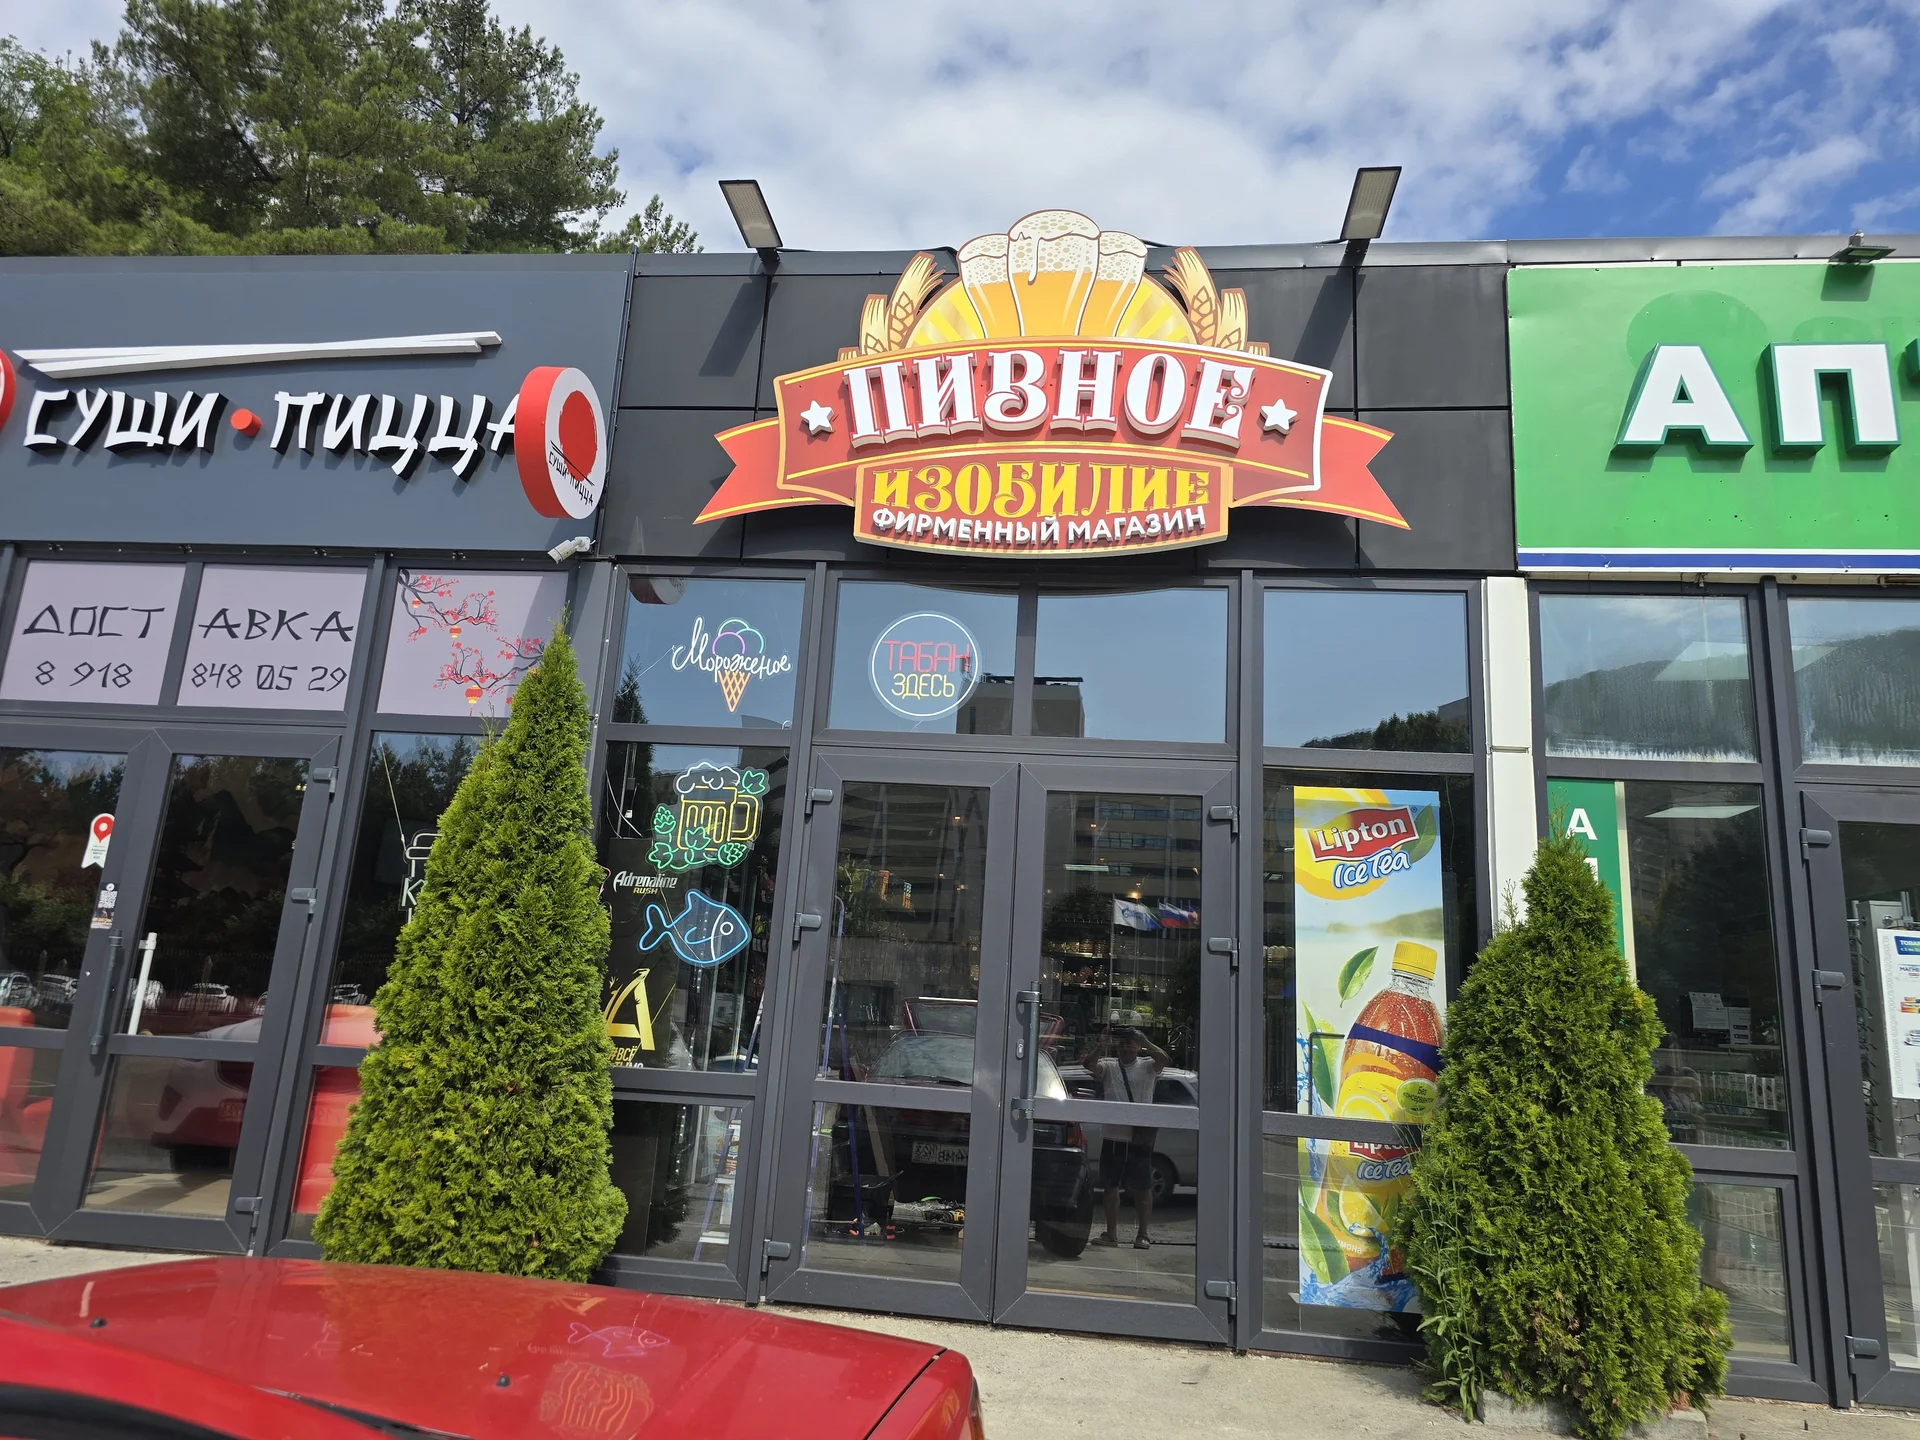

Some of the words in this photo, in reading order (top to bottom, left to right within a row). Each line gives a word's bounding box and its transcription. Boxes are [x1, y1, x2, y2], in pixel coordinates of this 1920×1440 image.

[843, 347, 1256, 449] ПИВНОЕ
[1614, 340, 1920, 449] АП
[23, 387, 226, 452] СУШИ
[548, 451, 568, 479] СУШИ
[569, 472, 594, 506] ПИЦЦА
[871, 460, 1210, 519] ИЗОБИЛИЕ
[872, 508, 1060, 544] ФИРМЕННЫЙ
[1068, 506, 1206, 543] МАГАЗИН
[23, 604, 166, 639] ДОСТ
[198, 607, 355, 643] АВКА
[672, 617, 791, 683] Мороженое
[35, 660, 56, 686] 8
[69, 661, 133, 689] 918
[191, 662, 243, 689] 848
[257, 664, 298, 691] 05
[308, 666, 348, 692] 29
[891, 673, 955, 700] ЗДЕСЬ
[1315, 818, 1408, 852] Lipton
[613, 870, 679, 893] Adrenaline
[1334, 863, 1369, 888] Ice
[1366, 848, 1410, 878] Tea
[632, 887, 659, 895] RUSH
[1358, 1162, 1383, 1179] Ice
[1338, 1240, 1362, 1255] мона
